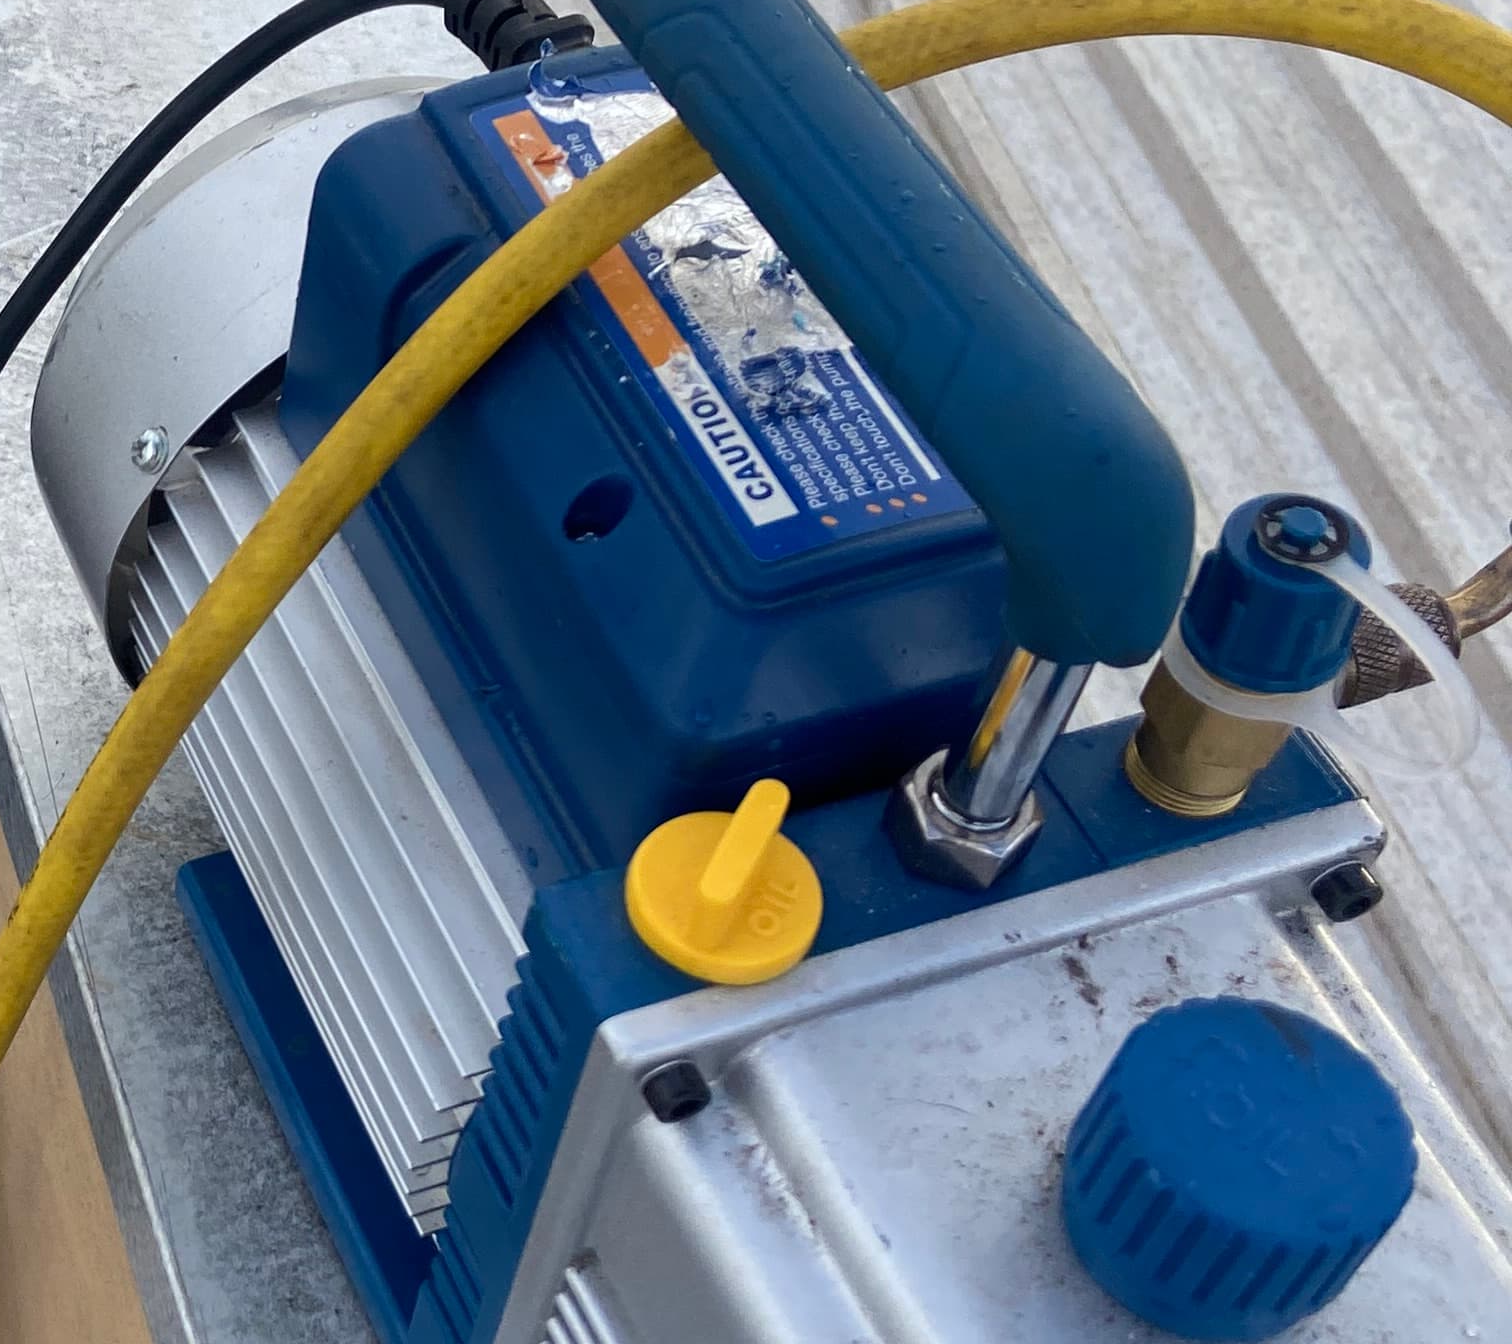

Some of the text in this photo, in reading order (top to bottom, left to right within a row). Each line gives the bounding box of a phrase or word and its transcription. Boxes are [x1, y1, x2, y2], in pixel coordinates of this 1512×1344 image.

[565, 132, 587, 153] the
[841, 387, 862, 412] the
[756, 421, 797, 463] check
[838, 422, 870, 456] keep
[853, 411, 891, 451] touch
[781, 416, 850, 503] specifications
[806, 412, 874, 498] Please check
[859, 456, 897, 493] Don't
[879, 449, 919, 488] Don't
[790, 461, 828, 510] Please
[748, 880, 800, 937] OIL
